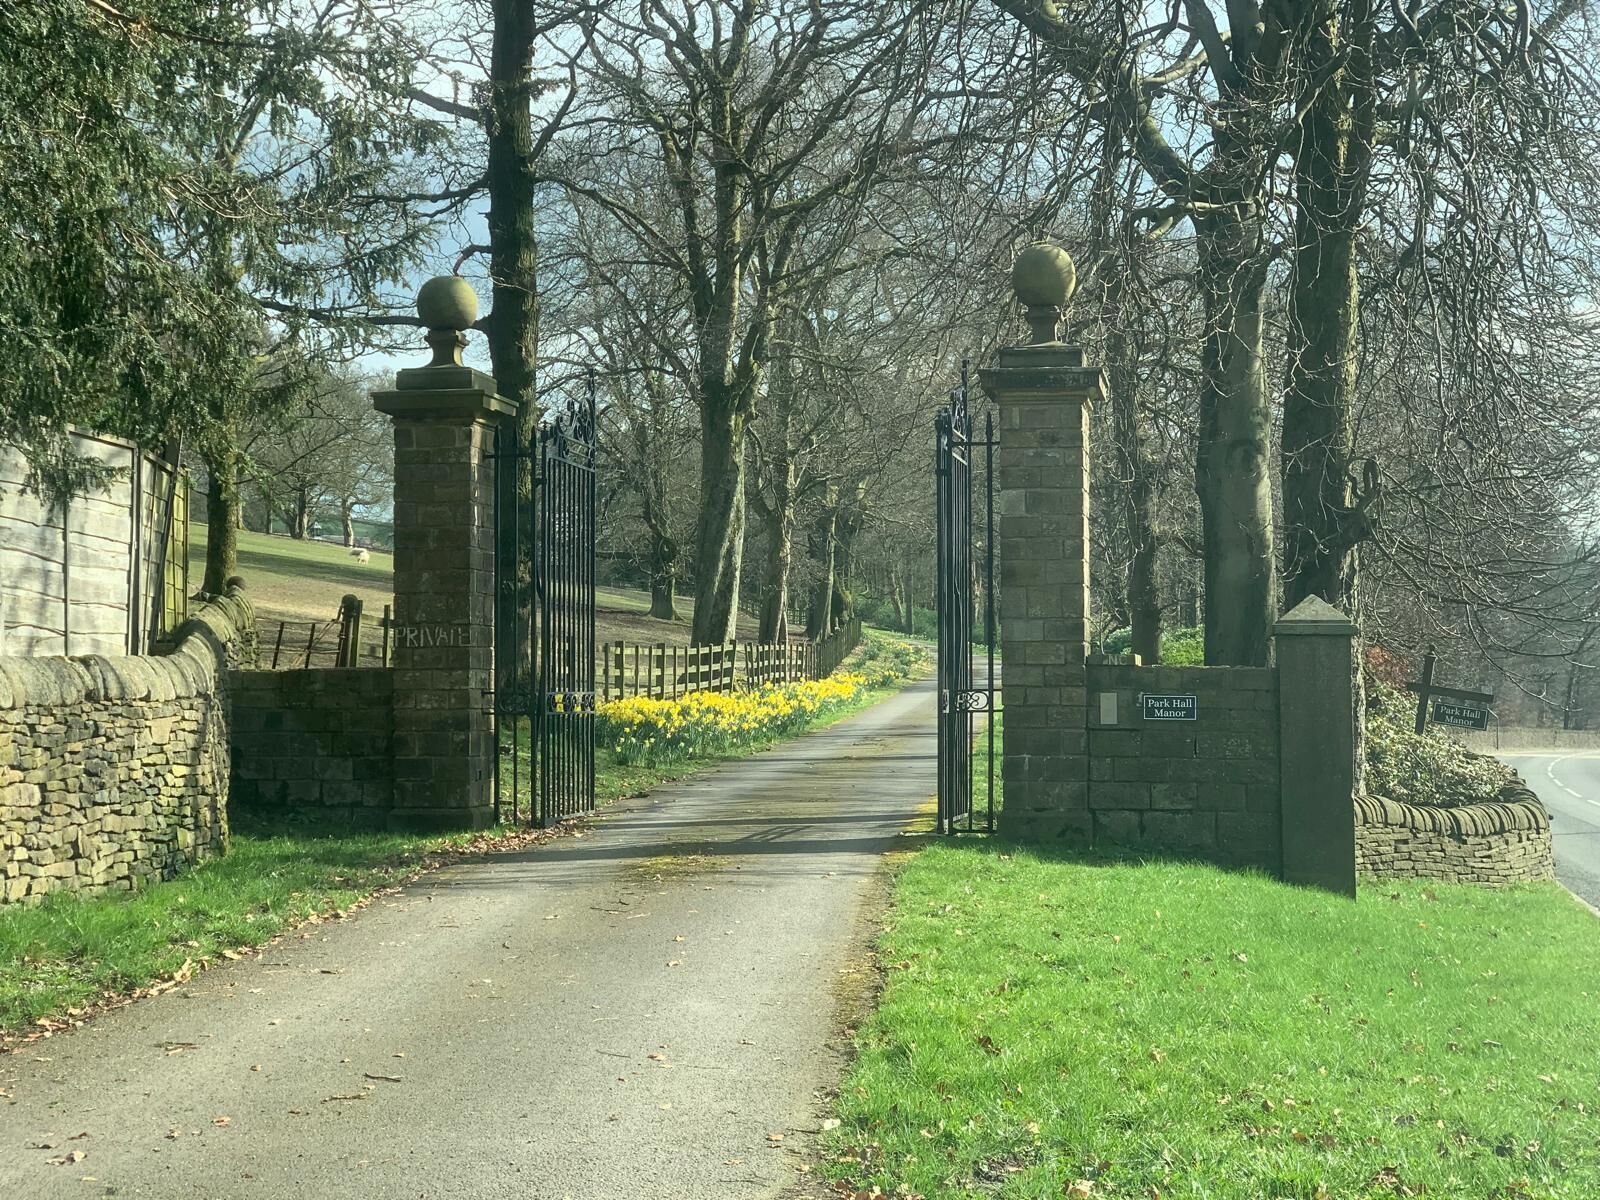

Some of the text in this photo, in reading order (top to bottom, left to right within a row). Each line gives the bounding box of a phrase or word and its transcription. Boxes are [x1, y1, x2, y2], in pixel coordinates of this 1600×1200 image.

[394, 626, 472, 648] PRIVATE
[1147, 698, 1193, 708] Park Hall
[1154, 708, 1187, 718] Manor
[1440, 705, 1481, 719] Park Hall
[1444, 715, 1475, 726] Manor
